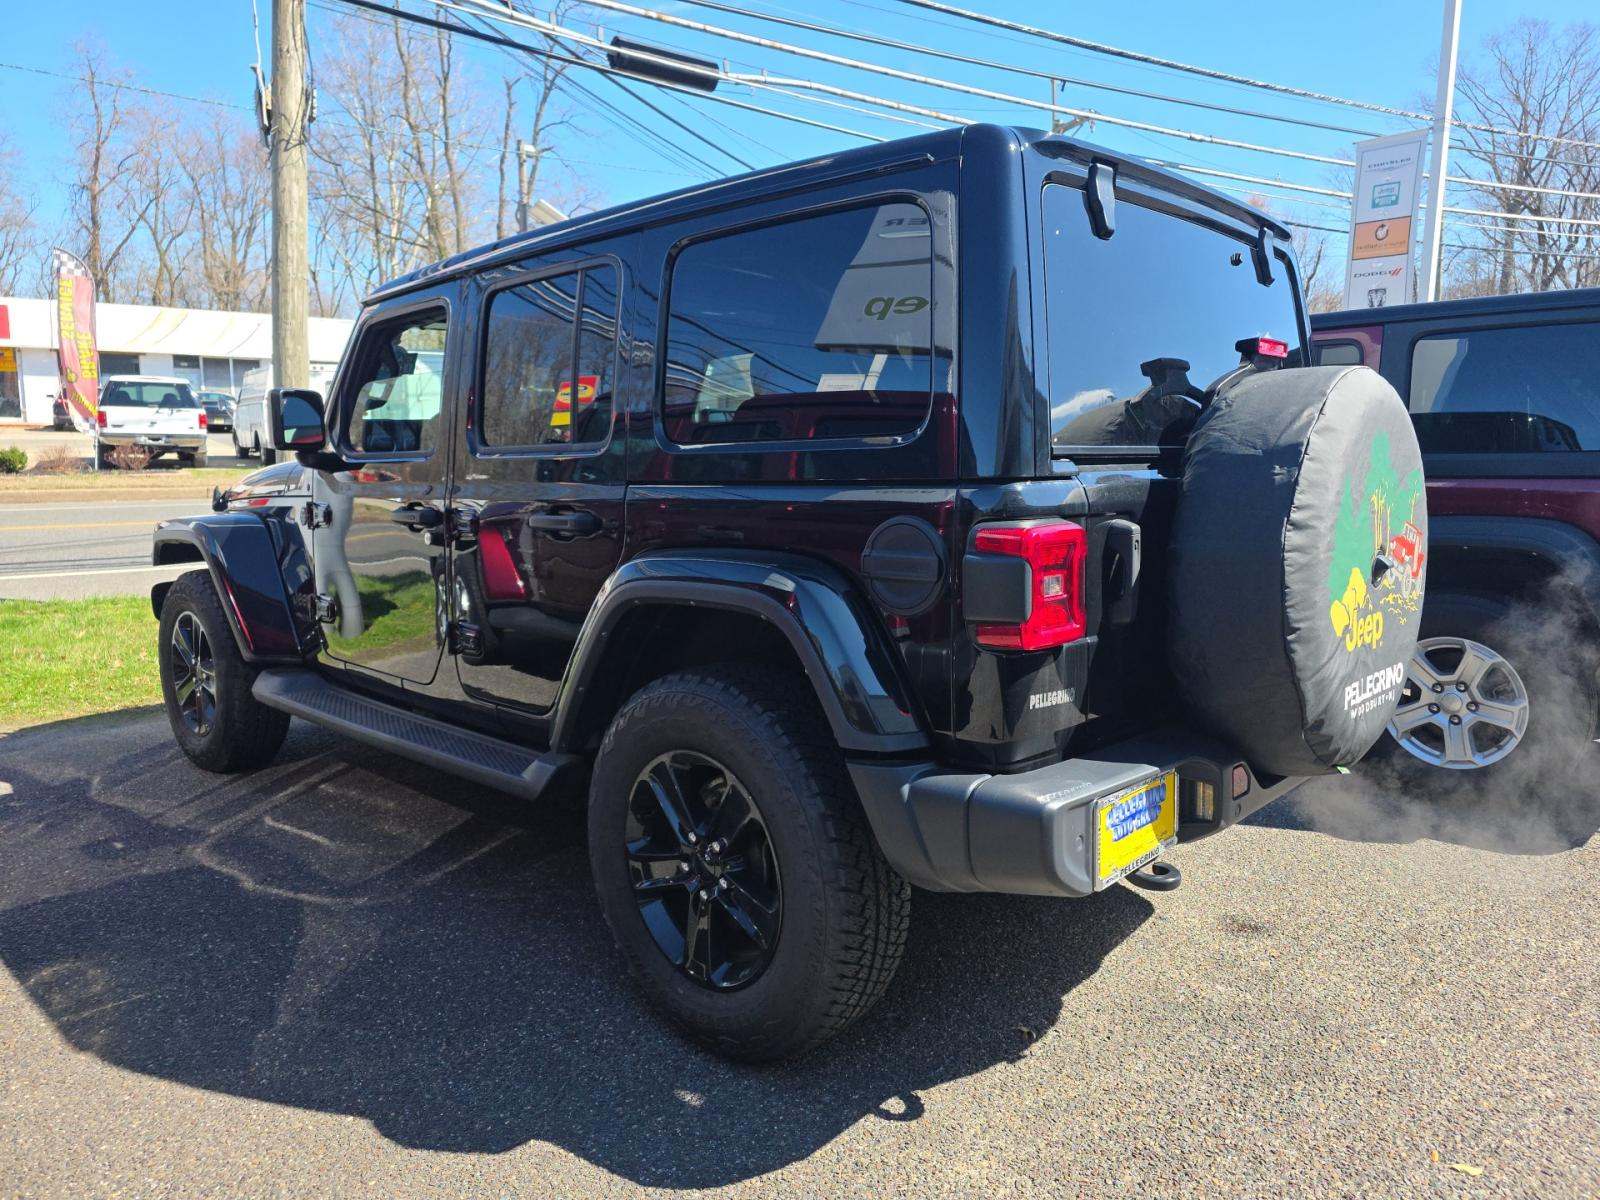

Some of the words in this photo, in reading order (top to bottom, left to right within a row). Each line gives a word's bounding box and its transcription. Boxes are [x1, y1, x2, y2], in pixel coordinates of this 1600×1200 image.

[1345, 608, 1383, 652] Jeep
[1029, 687, 1076, 711] PELLEGRINO
[1344, 662, 1404, 710] PELLEGRINO
[1121, 847, 1160, 876] PELLEGRINO
